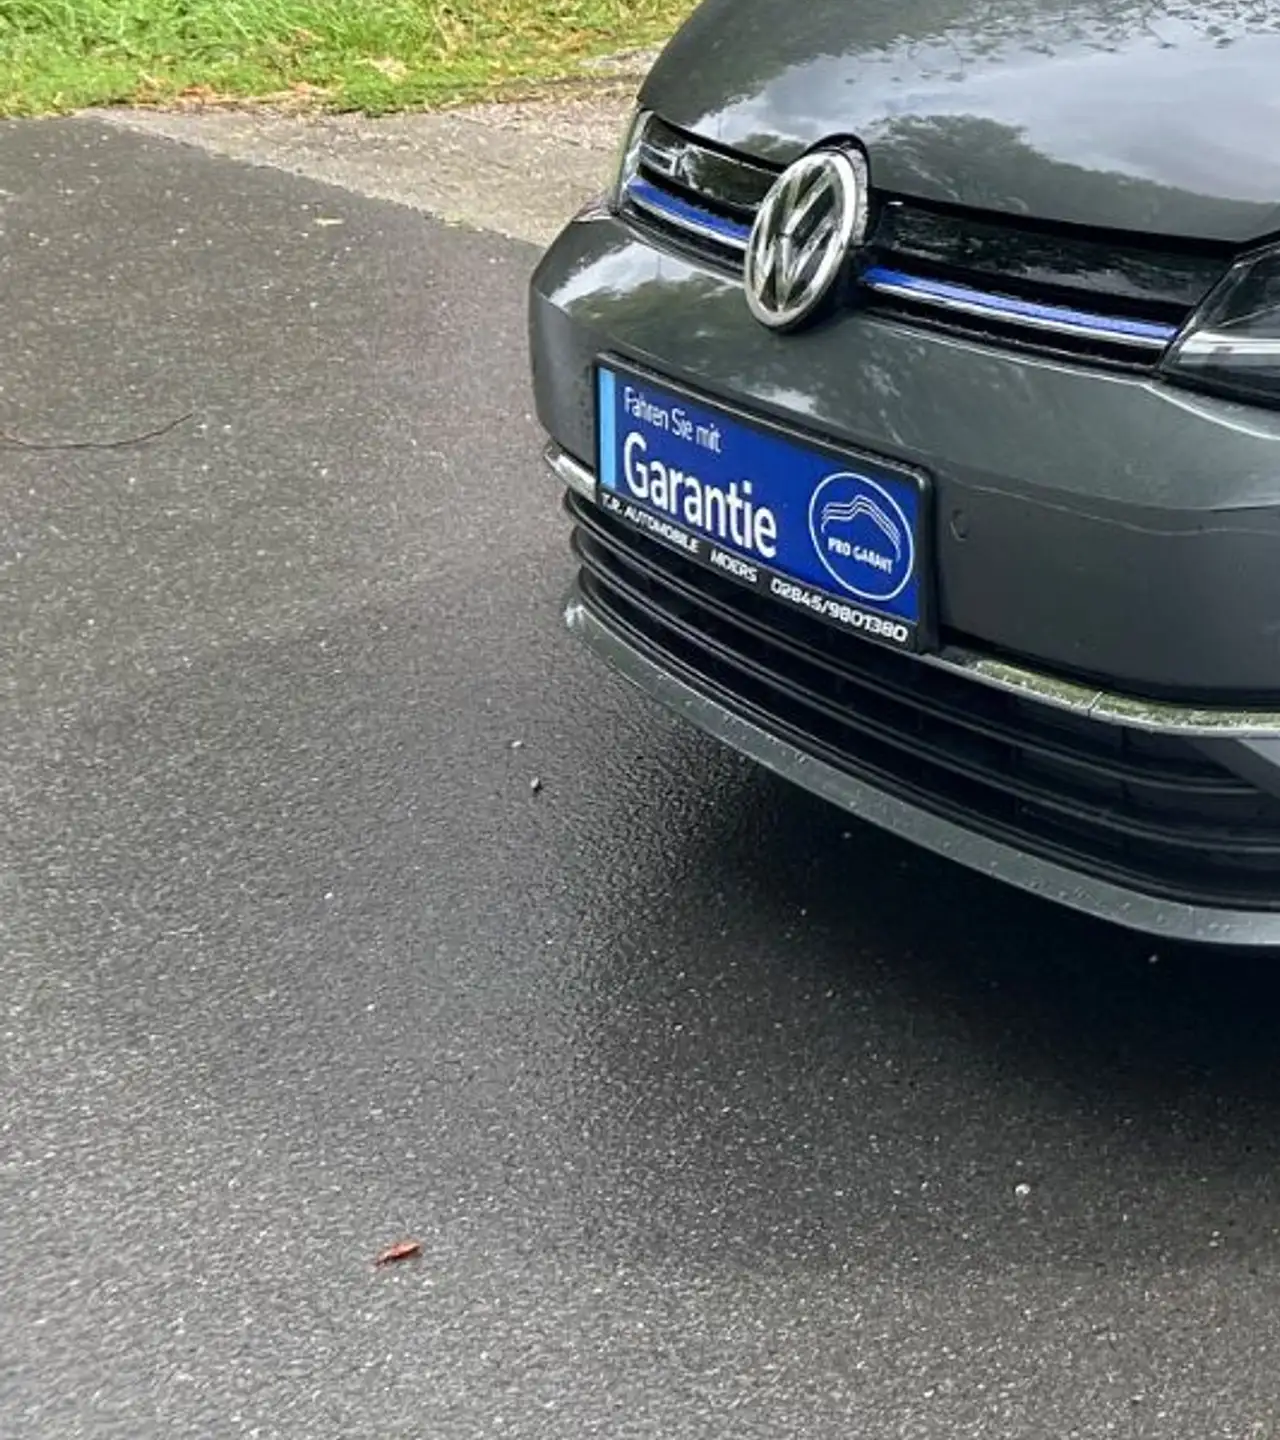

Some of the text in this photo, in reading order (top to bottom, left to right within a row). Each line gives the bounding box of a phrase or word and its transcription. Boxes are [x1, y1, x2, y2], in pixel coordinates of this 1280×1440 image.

[624, 386, 722, 453] Fahren Sie mit
[623, 431, 778, 558] Garantie
[624, 506, 700, 554] AUTOMOBILE
[710, 548, 759, 583] MOERS
